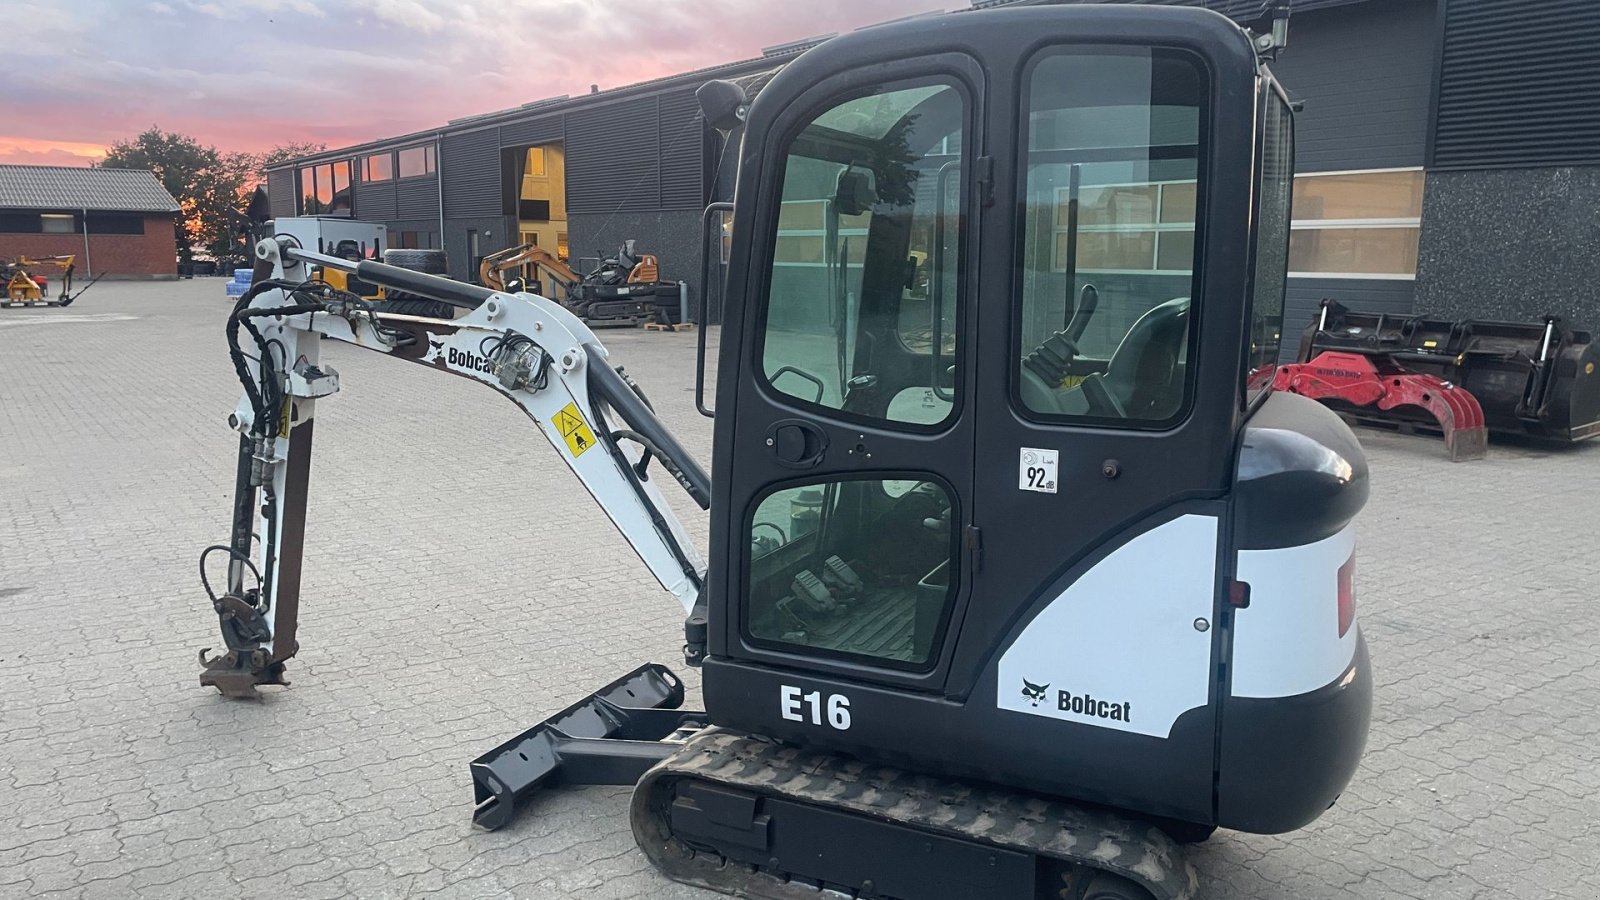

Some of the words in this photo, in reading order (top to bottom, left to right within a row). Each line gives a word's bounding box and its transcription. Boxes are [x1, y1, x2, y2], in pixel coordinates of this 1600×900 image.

[448, 347, 495, 375] Bobca
[1027, 466, 1046, 488] 92
[780, 684, 851, 731] E16
[1057, 689, 1131, 723] Bobcat
